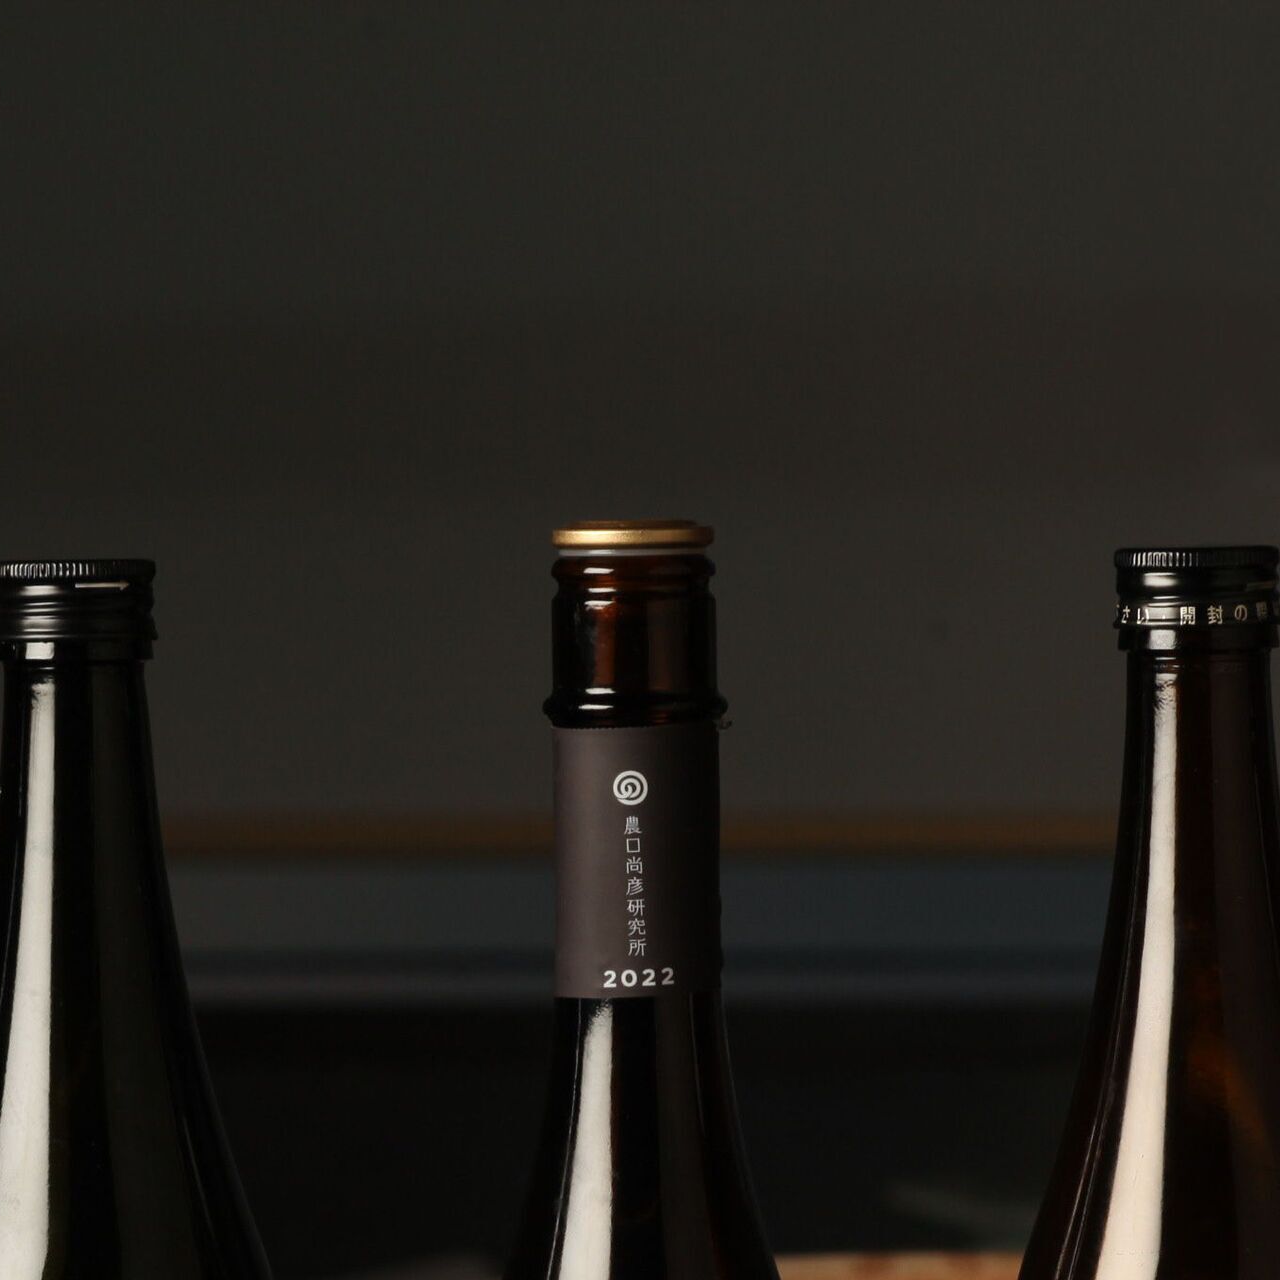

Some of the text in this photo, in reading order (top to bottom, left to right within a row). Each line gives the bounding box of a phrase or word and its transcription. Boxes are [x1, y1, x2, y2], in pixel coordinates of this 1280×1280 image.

[623, 815, 647, 957] 農口尚彦研究所
[602, 967, 675, 989] 2022
